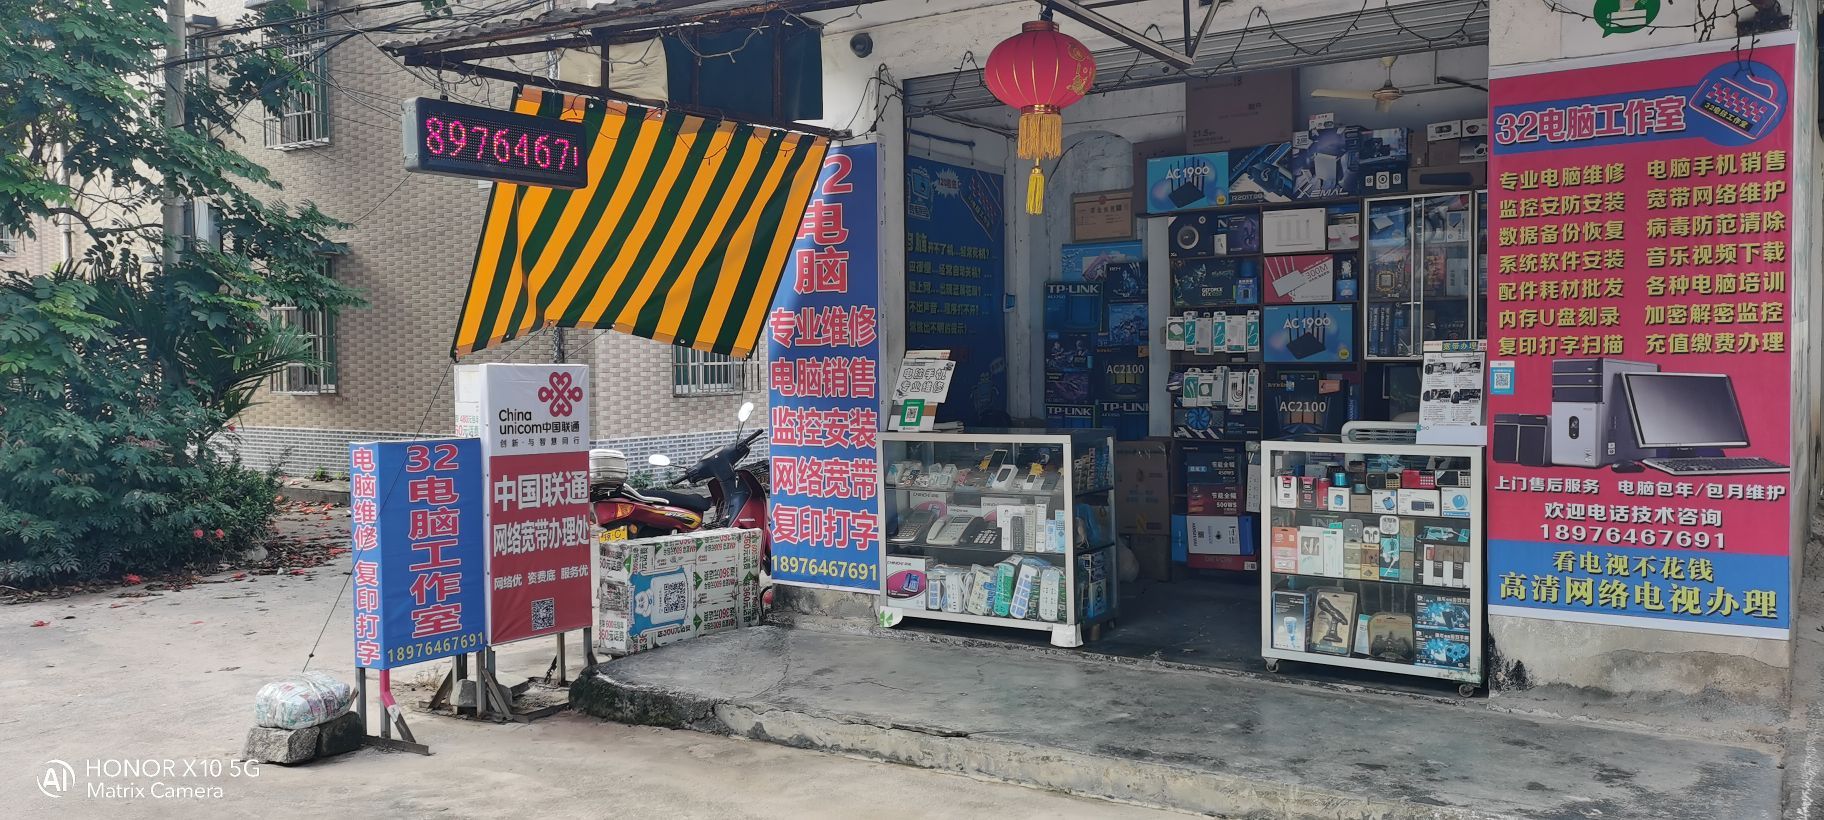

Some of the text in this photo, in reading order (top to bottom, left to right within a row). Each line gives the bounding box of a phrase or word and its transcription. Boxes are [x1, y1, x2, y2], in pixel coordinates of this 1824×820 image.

[1495, 94, 1686, 145] 32电脑工作室
[1704, 102, 1750, 130] 32电脑工作室
[1166, 166, 1211, 179] AC 1900
[1500, 163, 1626, 191] 专业电脑维修
[1647, 150, 1787, 180] 电脑手机销售
[1499, 192, 1625, 219] 监控安防安装
[1647, 180, 1787, 210] 宽带网络维护
[1499, 220, 1625, 247] 数据备份恢复
[1646, 210, 1786, 239] 病毒防范清除
[1499, 249, 1625, 275] 系统软件安装
[1646, 241, 1785, 268] 音乐视频下载
[1499, 277, 1624, 303] 配件耗材批发
[1646, 271, 1785, 297] 各种电脑培训
[769, 306, 877, 348] 专业维修
[1283, 317, 1331, 329] AC 1900
[1499, 306, 1620, 329] 内存U盘刻录
[1644, 302, 1784, 326] 加密解密监控
[1499, 334, 1624, 357] 复印打字扫描
[1646, 331, 1785, 354] 充值缴费办理
[770, 356, 876, 398] 电脑销售
[903, 367, 947, 381] 电脑手机
[1106, 363, 1145, 375] AC2100
[901, 380, 945, 393] 专业维修
[499, 408, 532, 422] China
[1102, 402, 1149, 412] TP-LIN
[1279, 401, 1327, 413] AC2100
[499, 420, 580, 436] unicom 中国联通
[771, 406, 877, 449] 监控安装
[771, 455, 877, 500] 网络宽带
[1495, 475, 1787, 502] 上门售后服务 电脑包年/包月维护
[494, 470, 589, 512] 中国联通
[772, 502, 879, 550] 复印打字
[1544, 502, 1723, 527] 欢迎电话技术咨询
[494, 514, 590, 558] 网络宽带办理处
[1540, 523, 1726, 548] 18976467691
[527, 570, 556, 586] 资费底
[561, 566, 589, 582] 服务优
[771, 554, 878, 581] 18976467691
[1553, 550, 1714, 582] 看电视不花钱
[493, 576, 523, 591] 网络优
[1498, 571, 1778, 619] 高清网络电视办理
[387, 631, 485, 663] 18976467691
